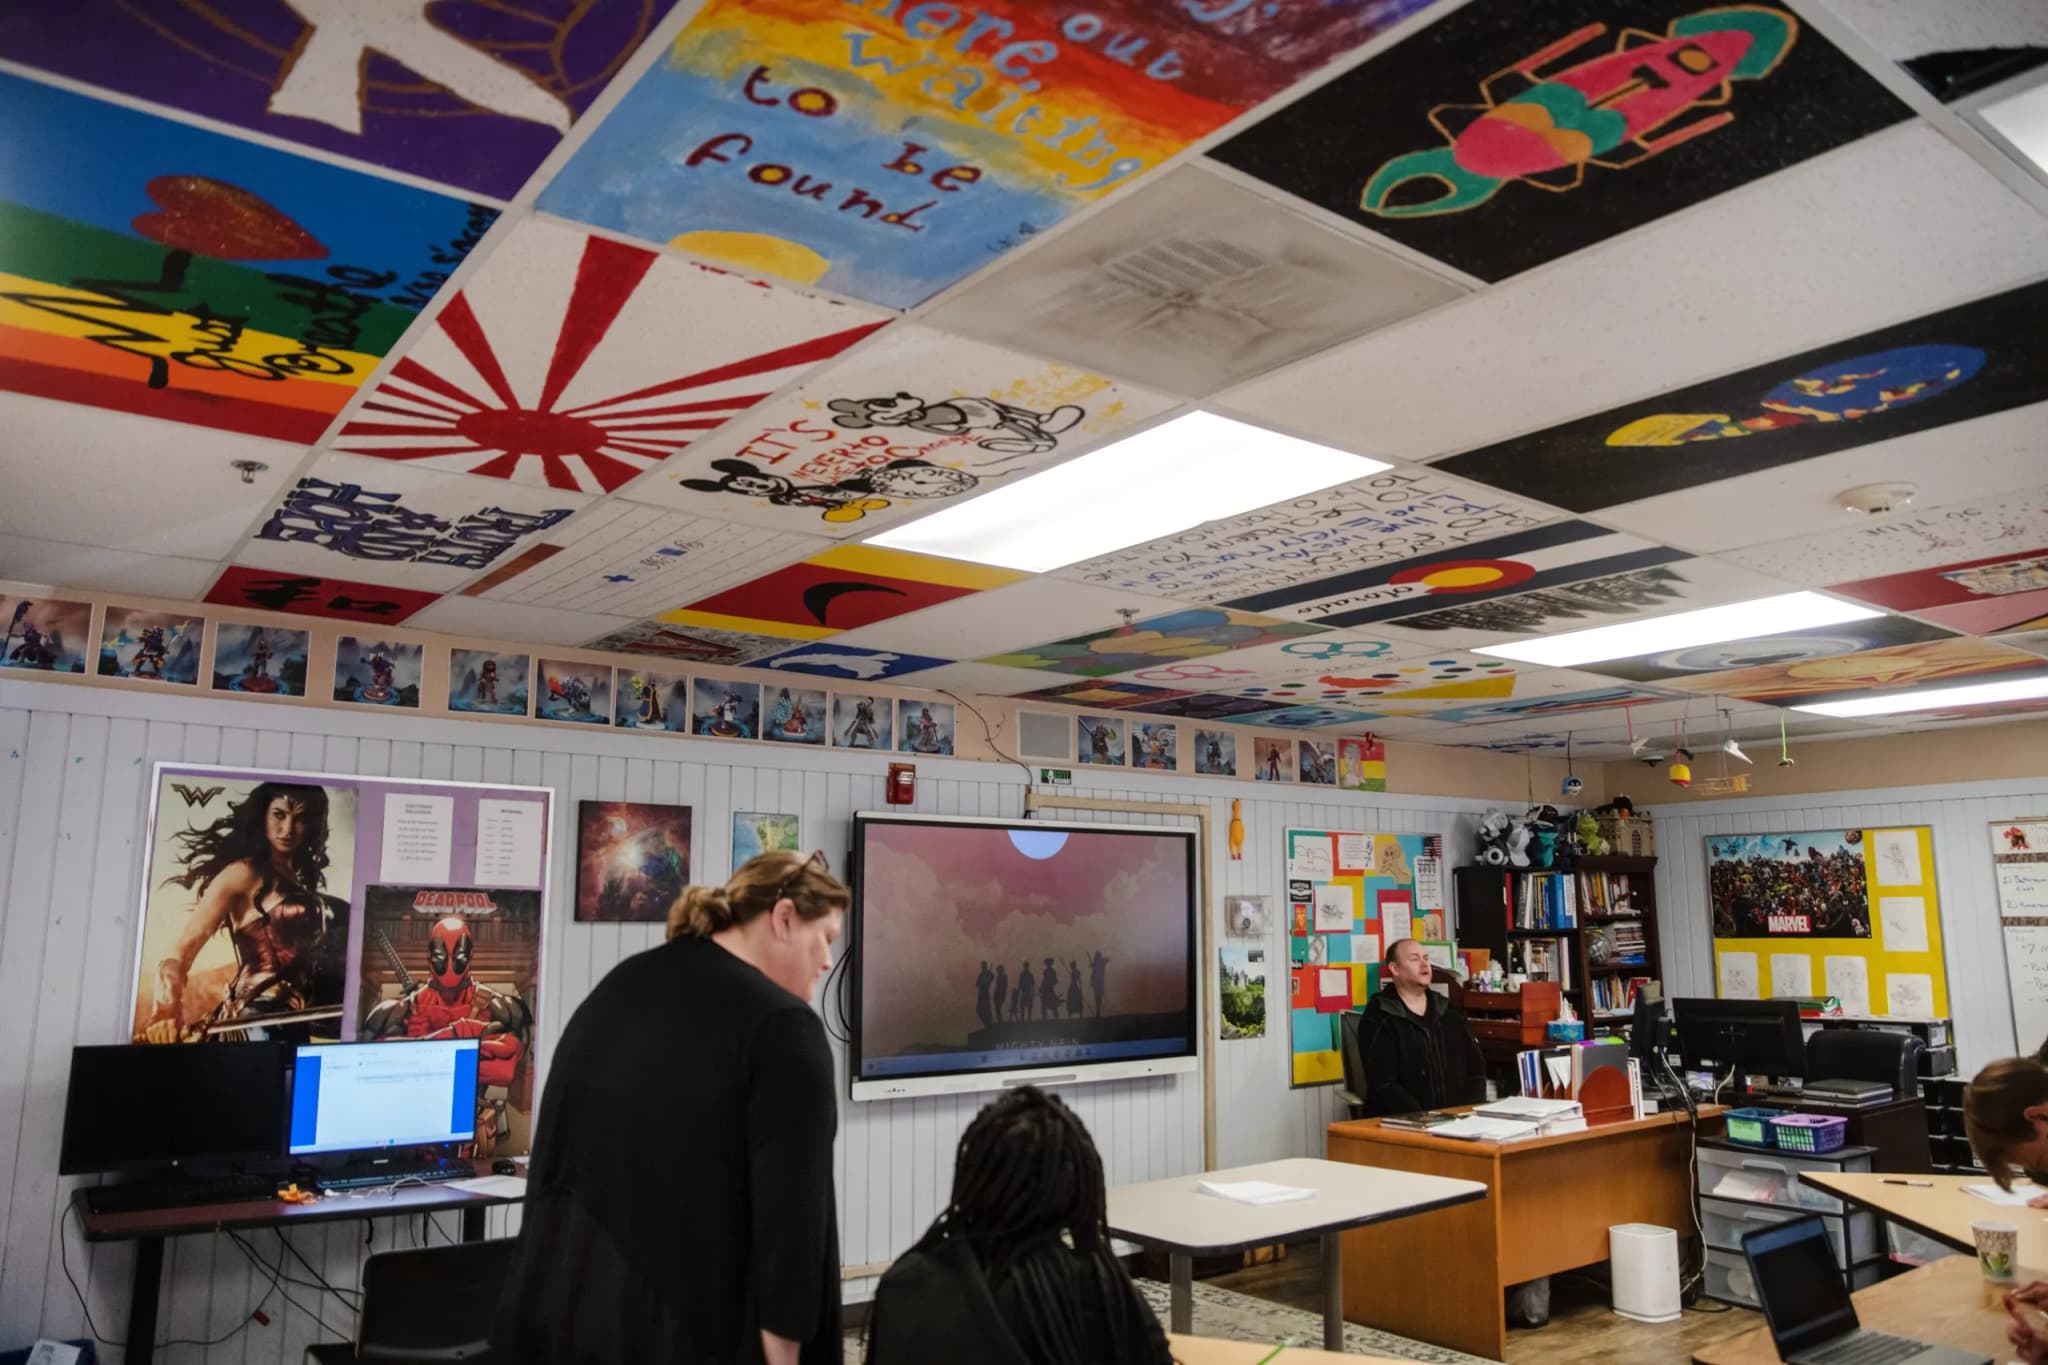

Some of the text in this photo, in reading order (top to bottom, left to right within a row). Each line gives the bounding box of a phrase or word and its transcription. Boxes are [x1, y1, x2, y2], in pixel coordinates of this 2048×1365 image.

[1062, 13, 1186, 80] out
[743, 65, 983, 192] to be
[684, 133, 938, 232] found
[413, 890, 498, 913] DEADPOOL
[1768, 915, 1812, 933] MARVEL
